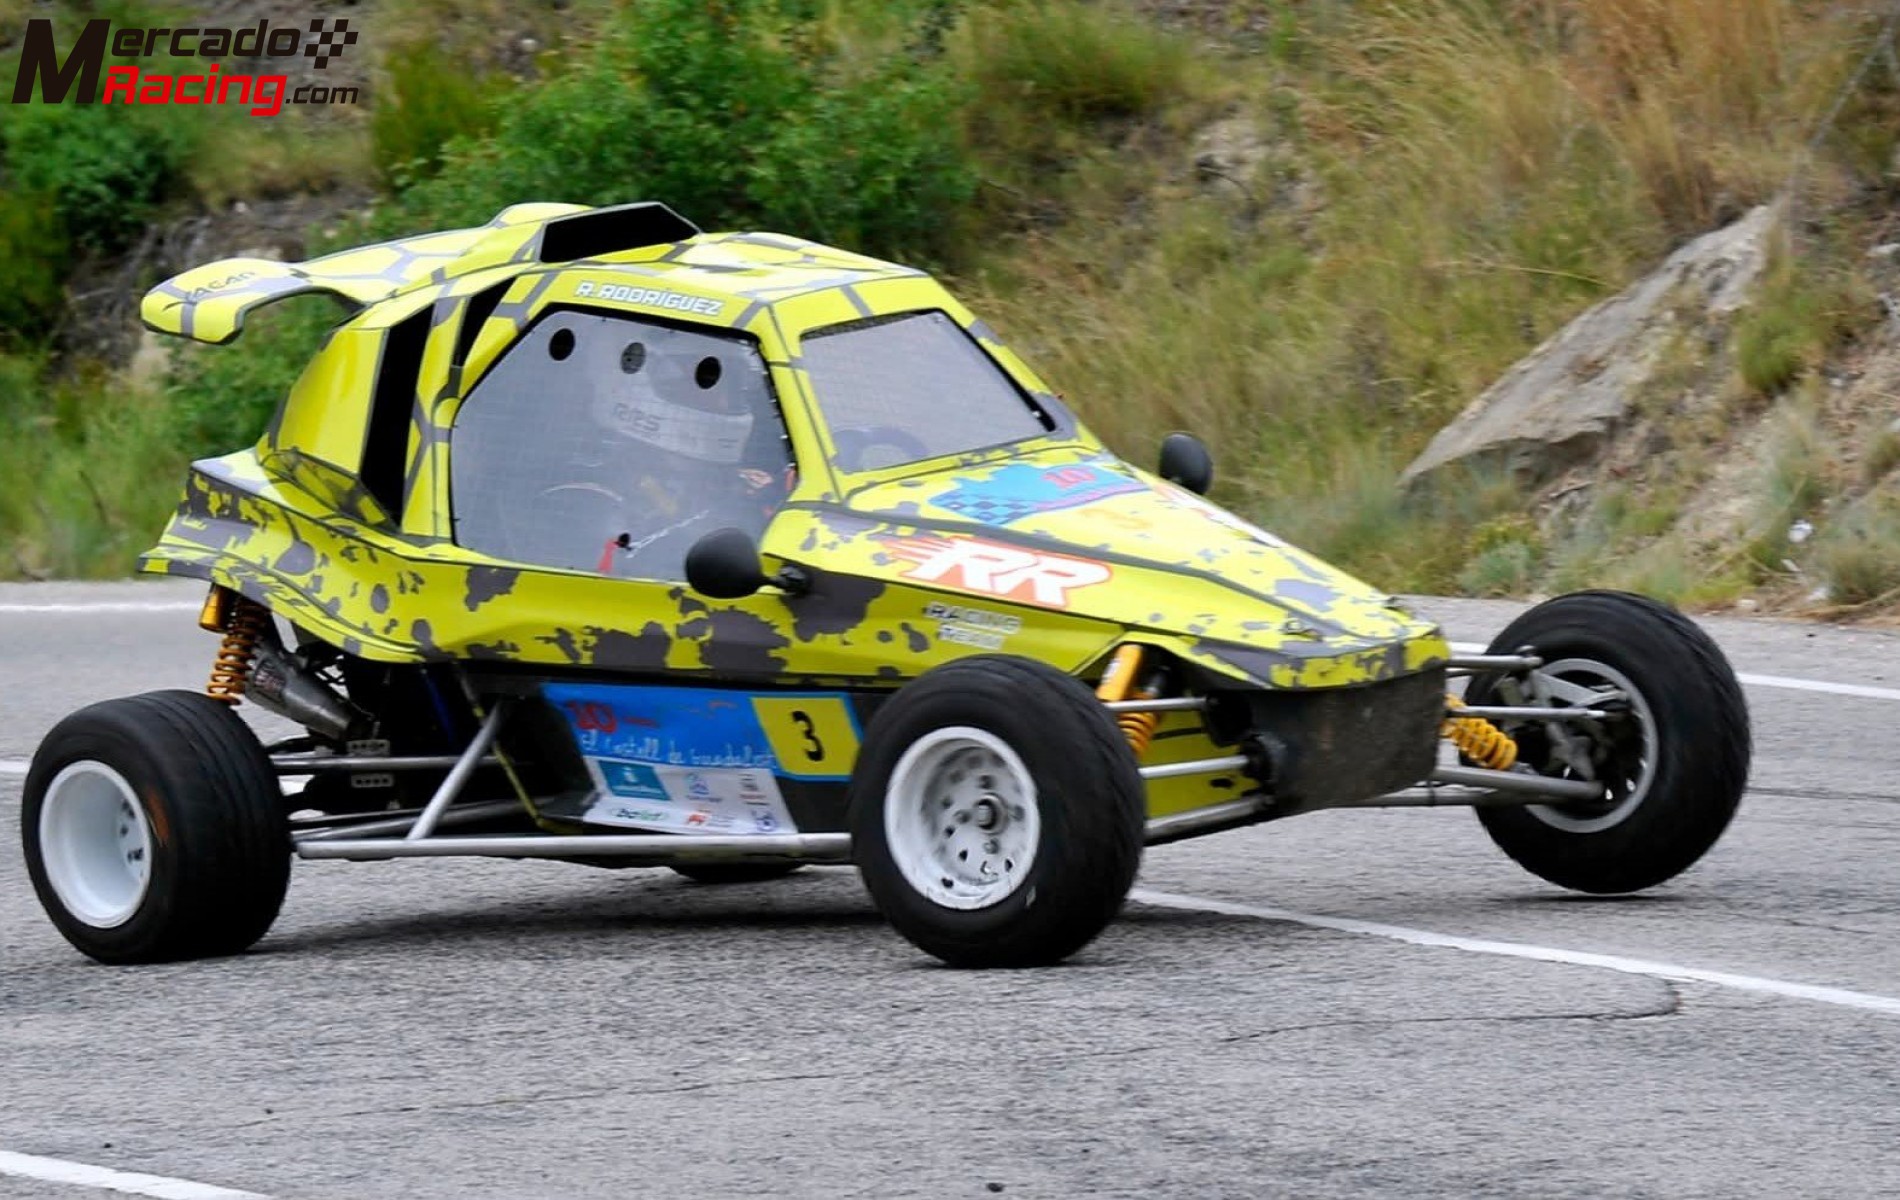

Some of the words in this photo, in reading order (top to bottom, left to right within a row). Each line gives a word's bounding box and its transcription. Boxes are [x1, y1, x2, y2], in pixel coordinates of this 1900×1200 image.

[575, 280, 595, 297] R.
[908, 538, 1112, 609] RR
[790, 710, 825, 762] 3
